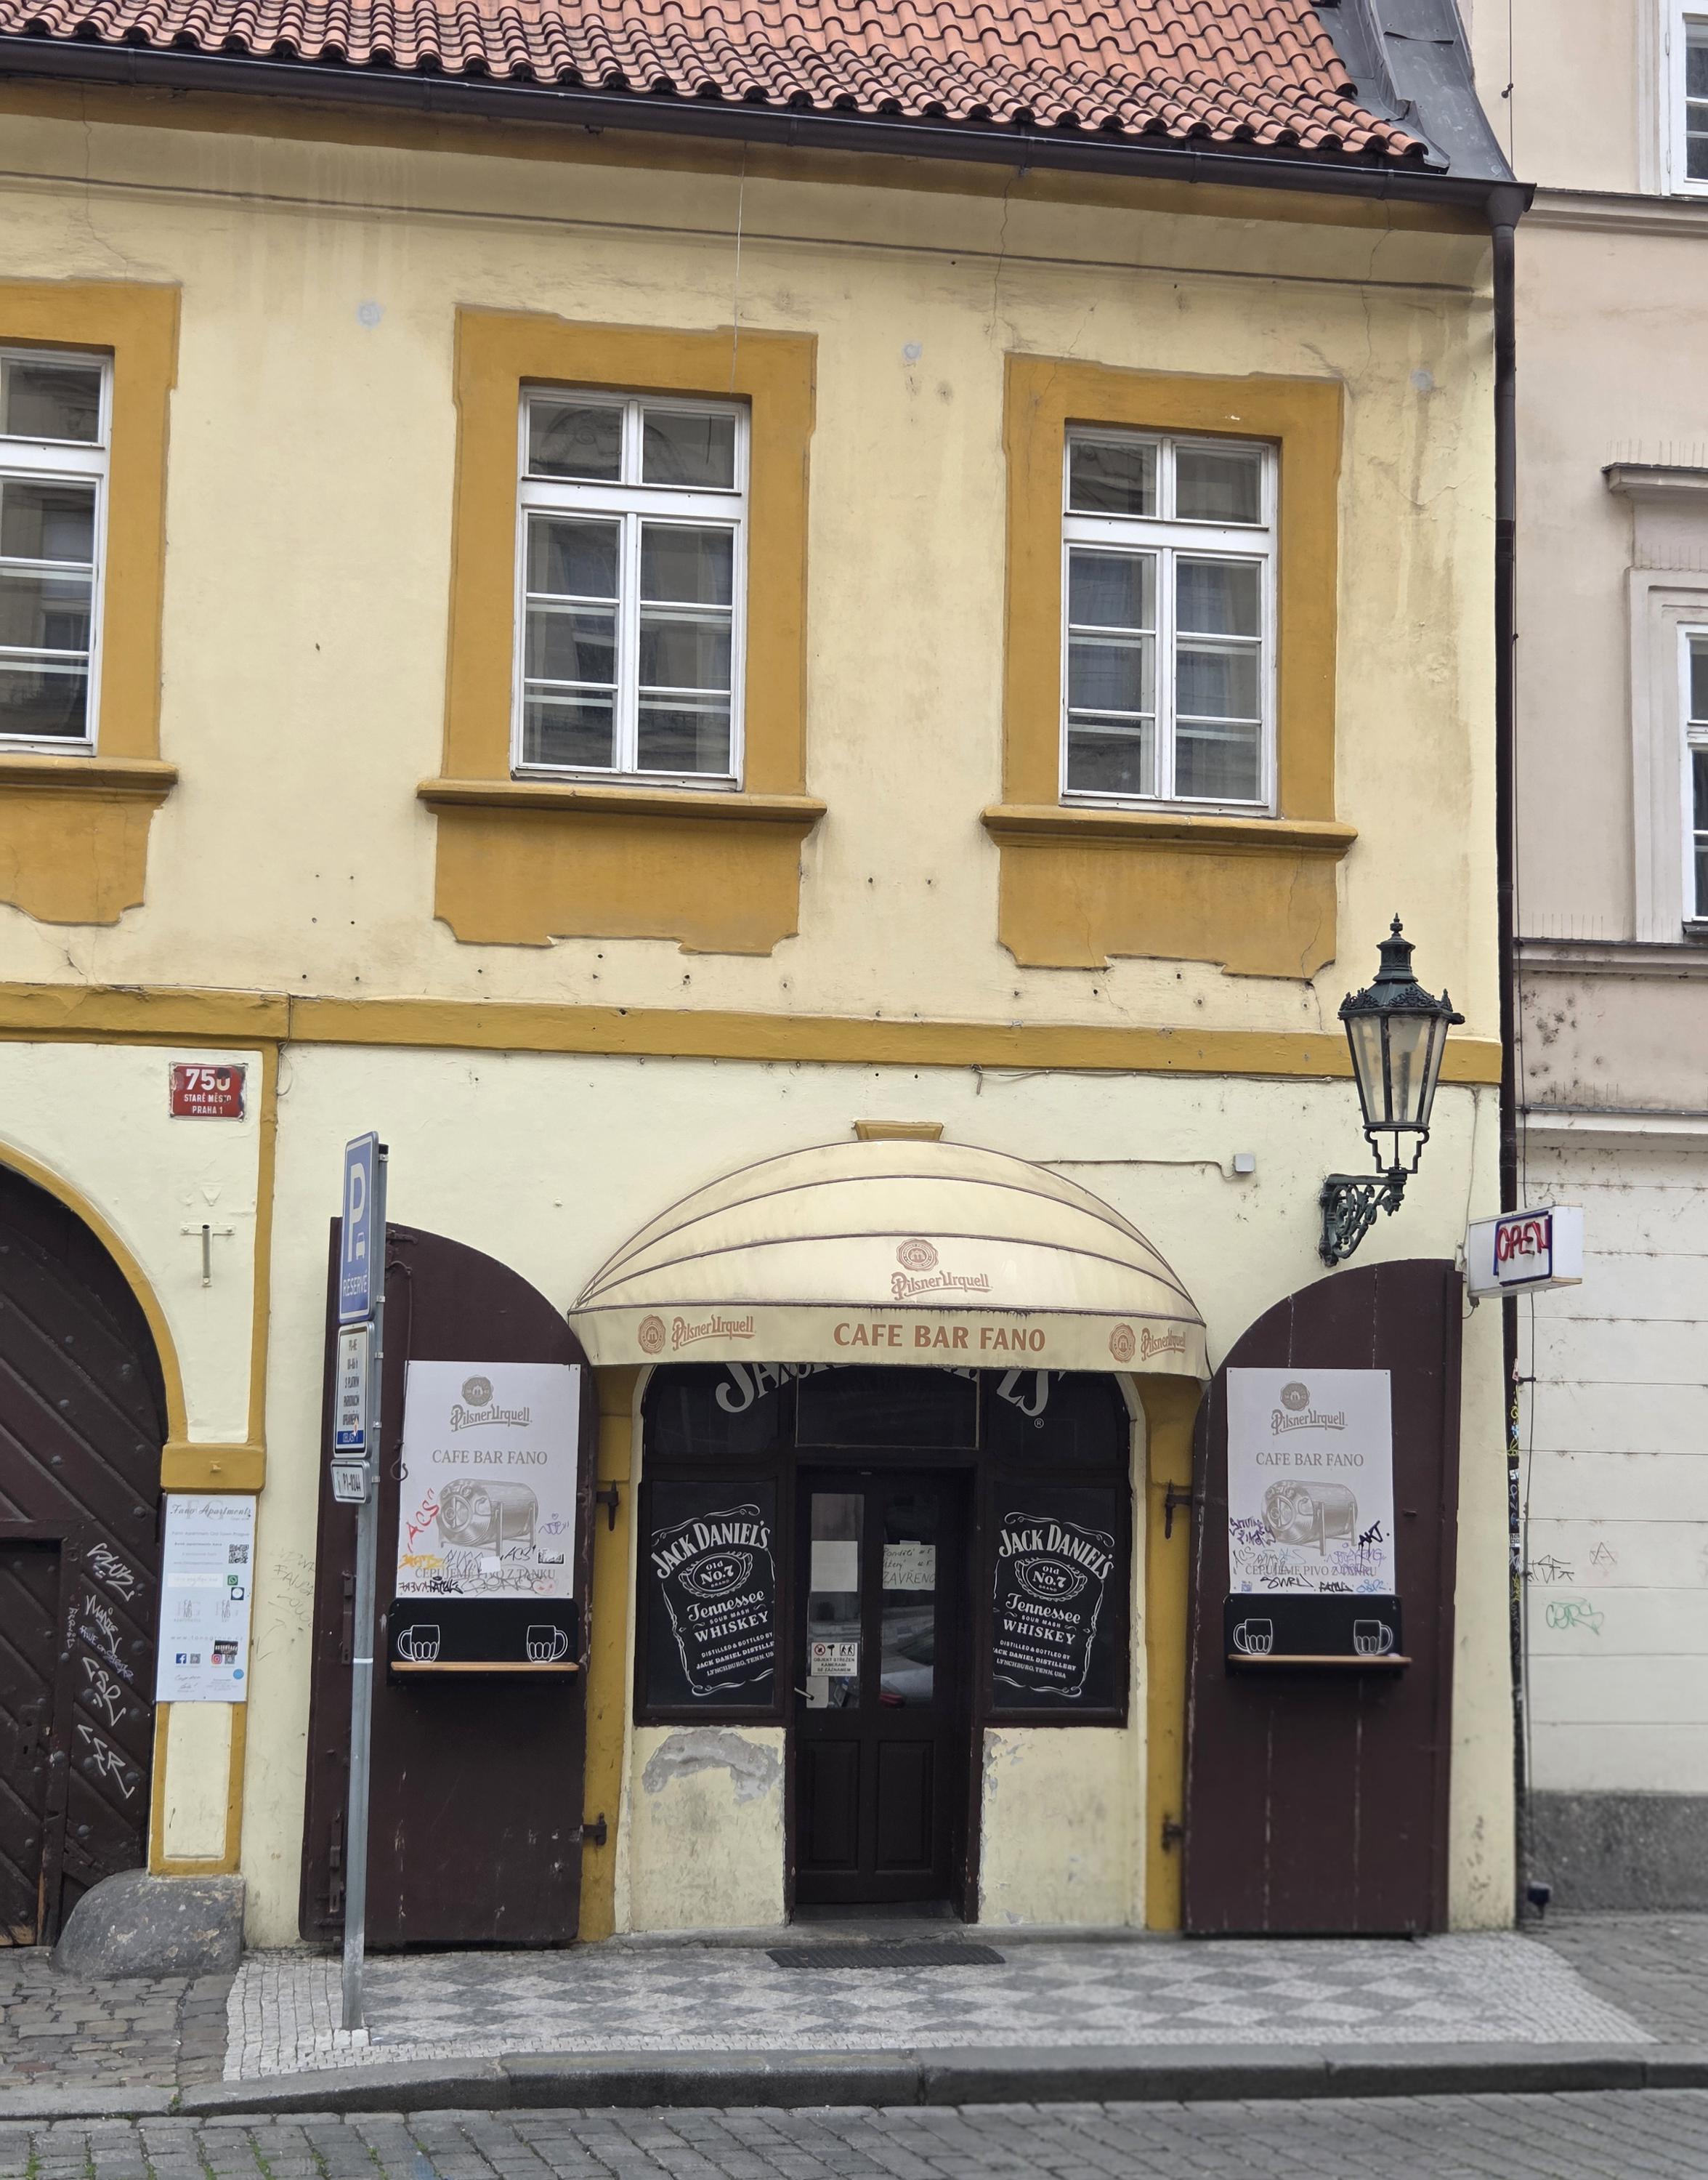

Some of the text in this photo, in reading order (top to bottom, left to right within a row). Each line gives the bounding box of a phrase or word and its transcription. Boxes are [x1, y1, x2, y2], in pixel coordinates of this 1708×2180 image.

[184, 1092, 206, 1102] STARÉ
[347, 1162, 366, 1263] P
[1497, 1219, 1549, 1261] OPEN
[891, 1270, 990, 1301] Pilsner Urquell
[671, 1316, 713, 1352] Pilsner
[711, 1314, 754, 1341] Urquell
[833, 1322, 1046, 1352] CAFE BAR FANO
[1141, 1328, 1168, 1362] Pilsner
[450, 1403, 530, 1433] Pilsner Urquell
[1271, 1408, 1345, 1436] Pilsner Urquell
[432, 1449, 548, 1465] CAFE BAR FANO
[1255, 1452, 1364, 1466] CAFE BAR FANO
[651, 1519, 771, 1579] JACK DANIEL'S
[998, 1524, 1114, 1580] JACK DANIEL'S
[705, 1560, 724, 1571] Old
[1043, 1565, 1059, 1575] Old
[1303, 1565, 1329, 1576] PIVO
[687, 1591, 765, 1621] Tennessee
[709, 1608, 750, 1625] SOUR MASH
[1005, 1592, 1081, 1624] Tennessee
[694, 1610, 769, 1642] WHISKEY
[1003, 1618, 1076, 1645] WHISKEY
[1021, 1615, 1061, 1628] SOUR MASH
[701, 1644, 732, 1658] DISTILLED
[738, 1634, 764, 1647] BOTTLED
[992, 1647, 1077, 1671] ACK DANIEL DISTILLERY
[1000, 1639, 1029, 1651] DISTILLED
[1035, 1647, 1062, 1659] BOTTLED
[696, 1660, 714, 1670] JACK
[716, 1652, 742, 1663] DANIEL
